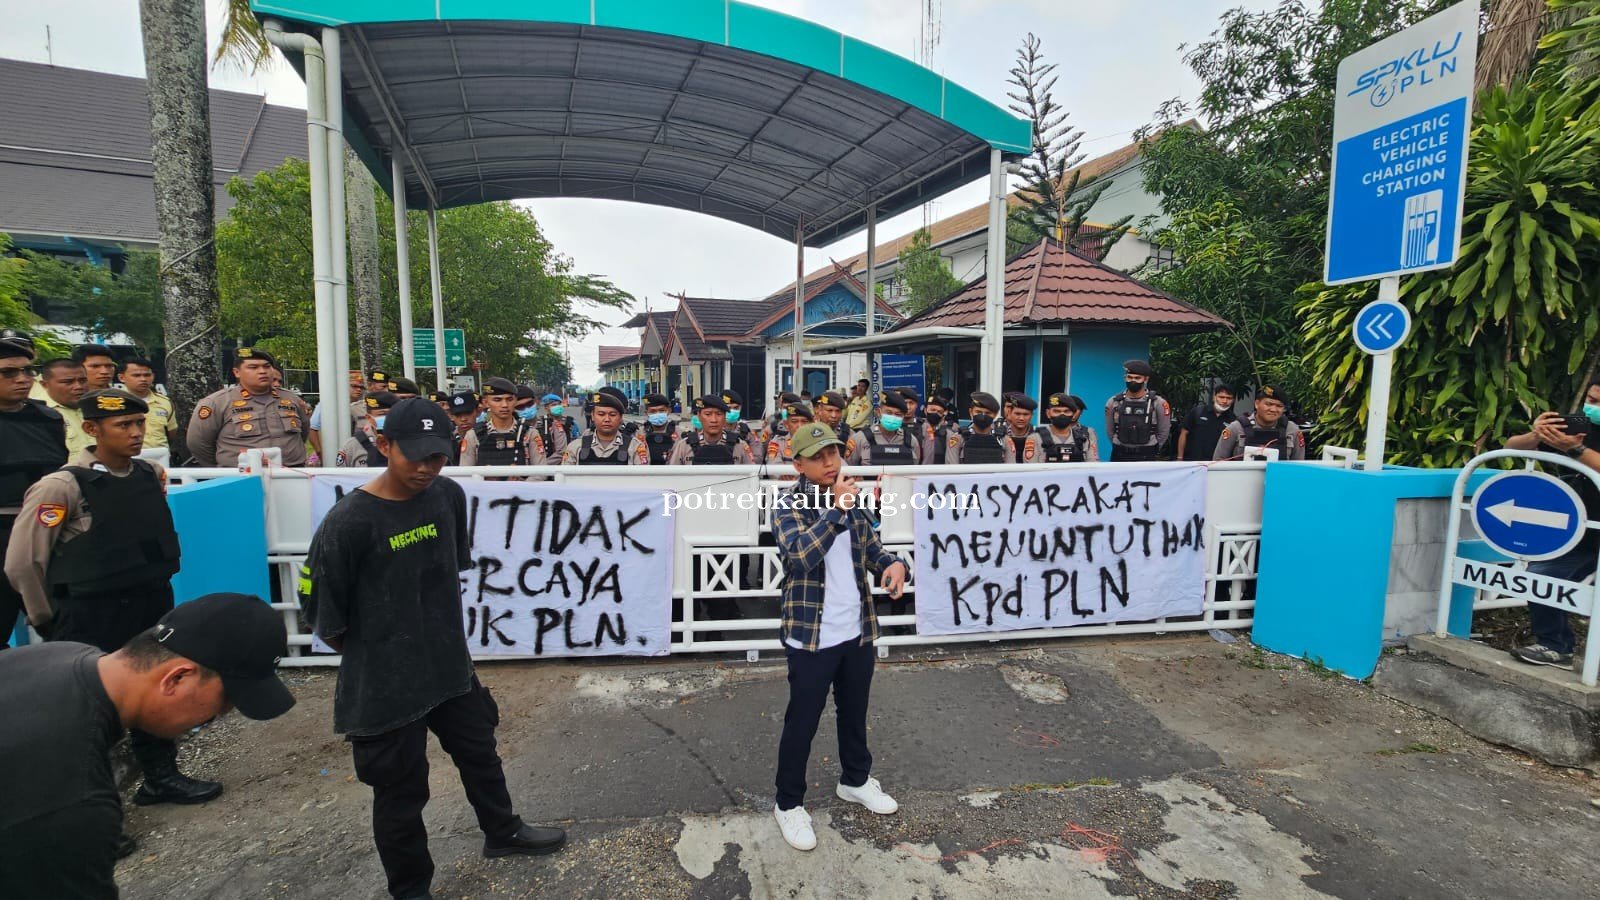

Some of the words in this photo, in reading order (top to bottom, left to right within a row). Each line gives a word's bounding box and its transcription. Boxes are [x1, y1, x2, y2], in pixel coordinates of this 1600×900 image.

[1347, 31, 1463, 97] SPKLU
[1400, 56, 1457, 94] PLN
[1373, 113, 1450, 151] ELECTRIC
[1380, 131, 1449, 164] VEHICLE
[1362, 150, 1447, 186] CHARGING
[1376, 167, 1446, 198] STATION
[927, 475, 1162, 523] MASYARAKAT
[389, 523, 438, 552] HECKING
[489, 496, 656, 555] TIDAK
[1041, 558, 1131, 621] PLN
[1462, 563, 1578, 608] MASUK
[532, 607, 648, 656] PLN.
